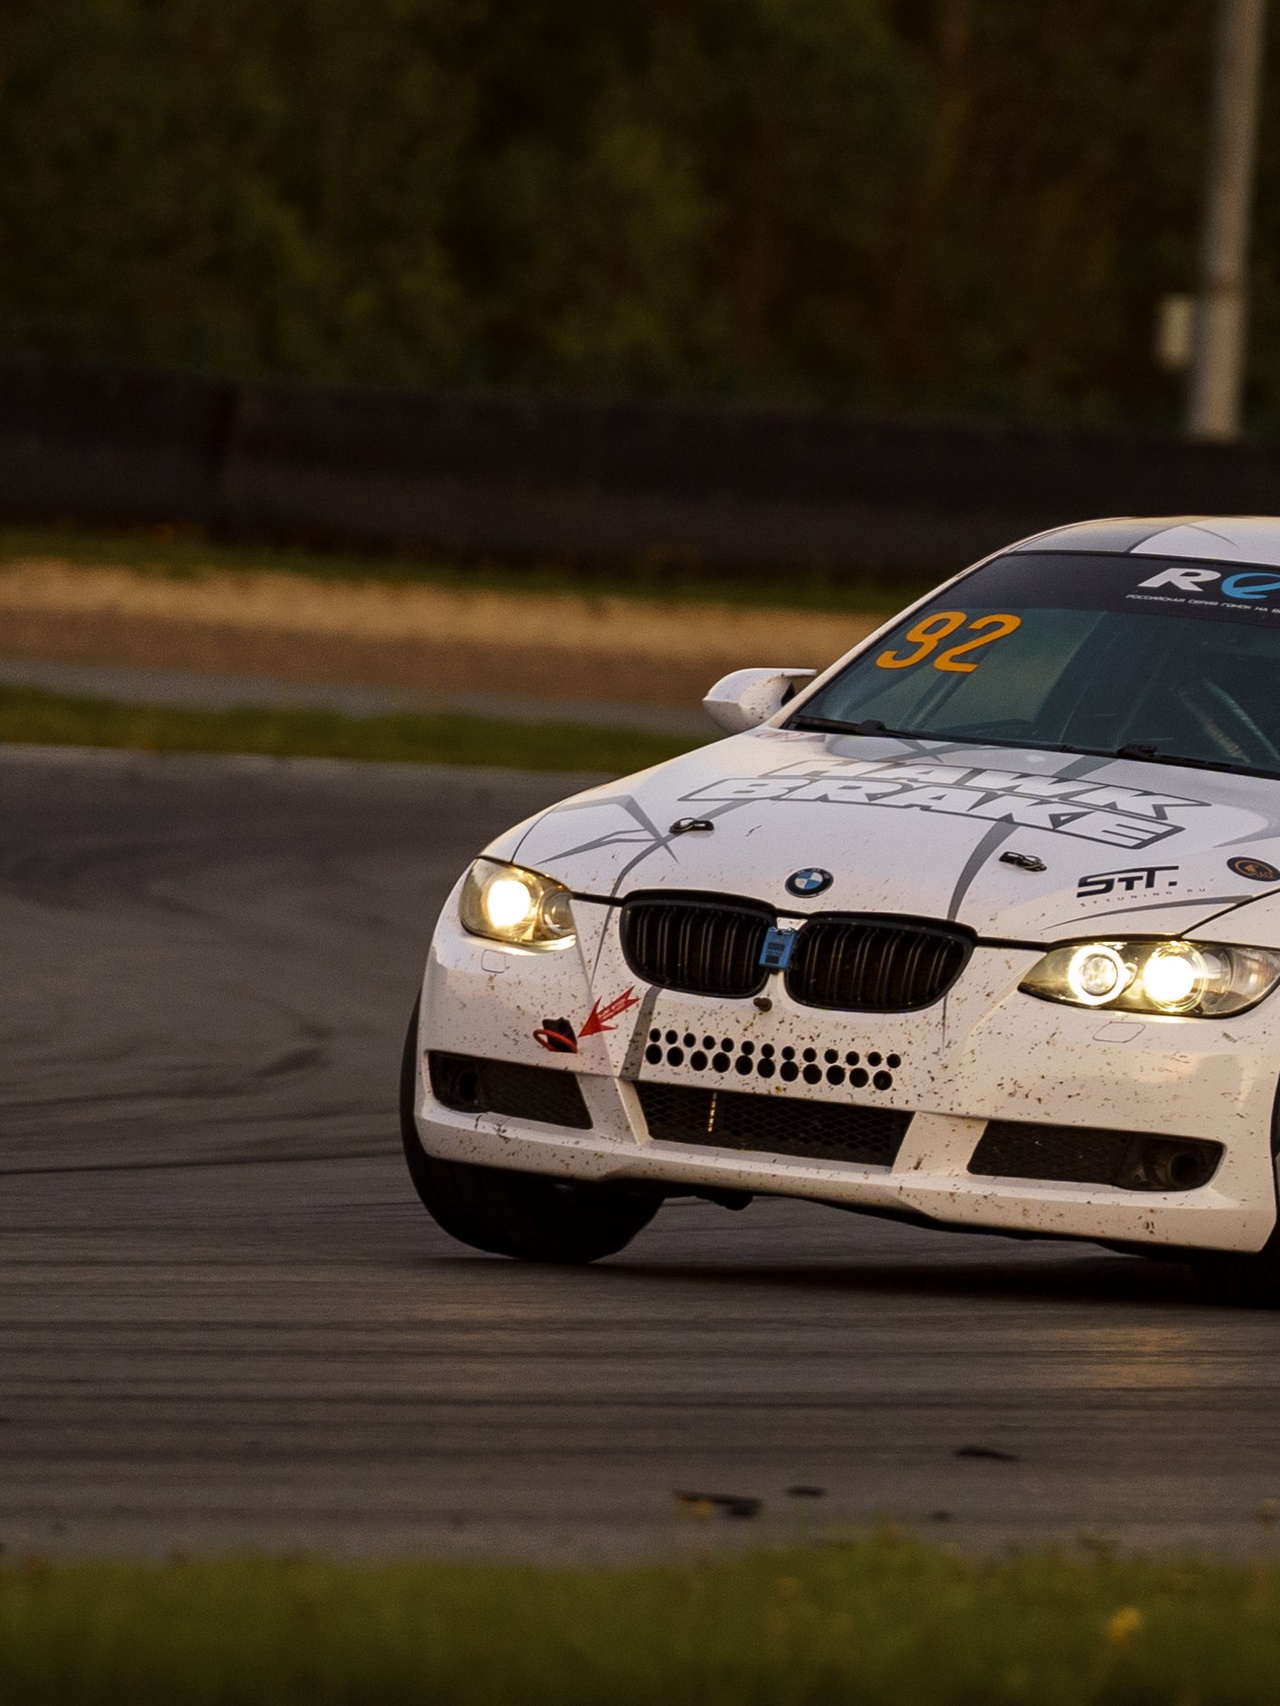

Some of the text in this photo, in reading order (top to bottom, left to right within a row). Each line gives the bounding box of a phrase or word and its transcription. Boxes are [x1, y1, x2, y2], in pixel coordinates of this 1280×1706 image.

[875, 610, 1023, 673] 92
[676, 776, 1187, 850] BRAKE
[757, 759, 1214, 821] HAWK
